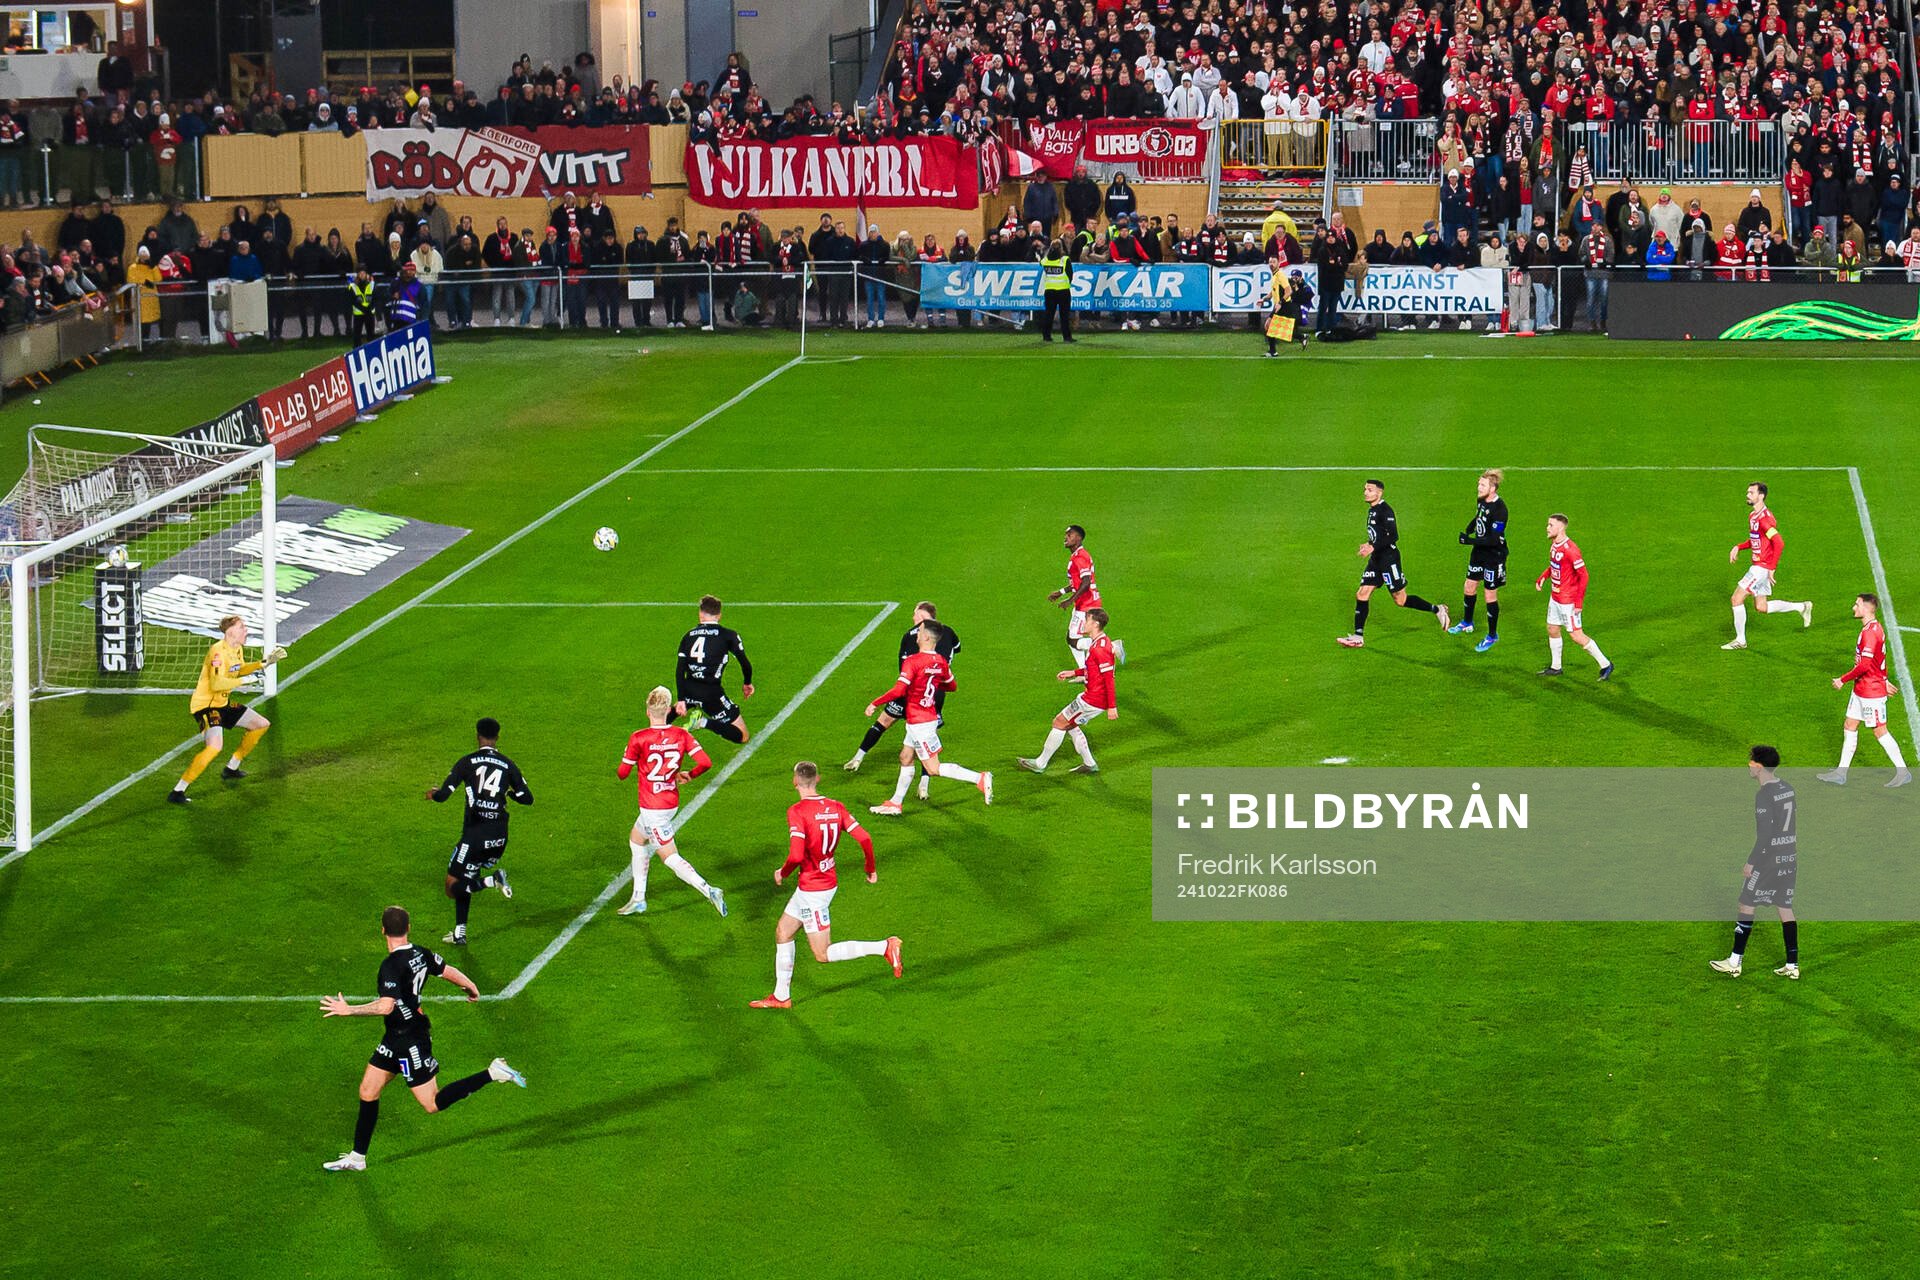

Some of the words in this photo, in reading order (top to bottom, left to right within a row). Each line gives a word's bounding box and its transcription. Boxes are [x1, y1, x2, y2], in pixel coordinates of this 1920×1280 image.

[479, 126, 537, 154] EGERFORS
[1047, 130, 1082, 142] VALLA
[1095, 134, 1140, 155] URB
[1174, 135, 1197, 156] 03
[370, 141, 463, 190] RÖD
[539, 151, 629, 186] VITT
[694, 144, 958, 197] VULKANERN
[957, 297, 977, 307] Gas
[980, 297, 987, 307] &
[1160, 299, 1172, 309] 35
[348, 328, 433, 410] Helmia
[308, 370, 349, 411] D-LAB
[262, 393, 308, 434] D-LAB
[101, 582, 127, 672] SELECT
[690, 636, 706, 664] 4
[924, 675, 936, 700] 6
[475, 765, 503, 798] 14
[647, 750, 680, 782] 23
[1782, 801, 1793, 832] 7
[819, 823, 839, 856] 11
